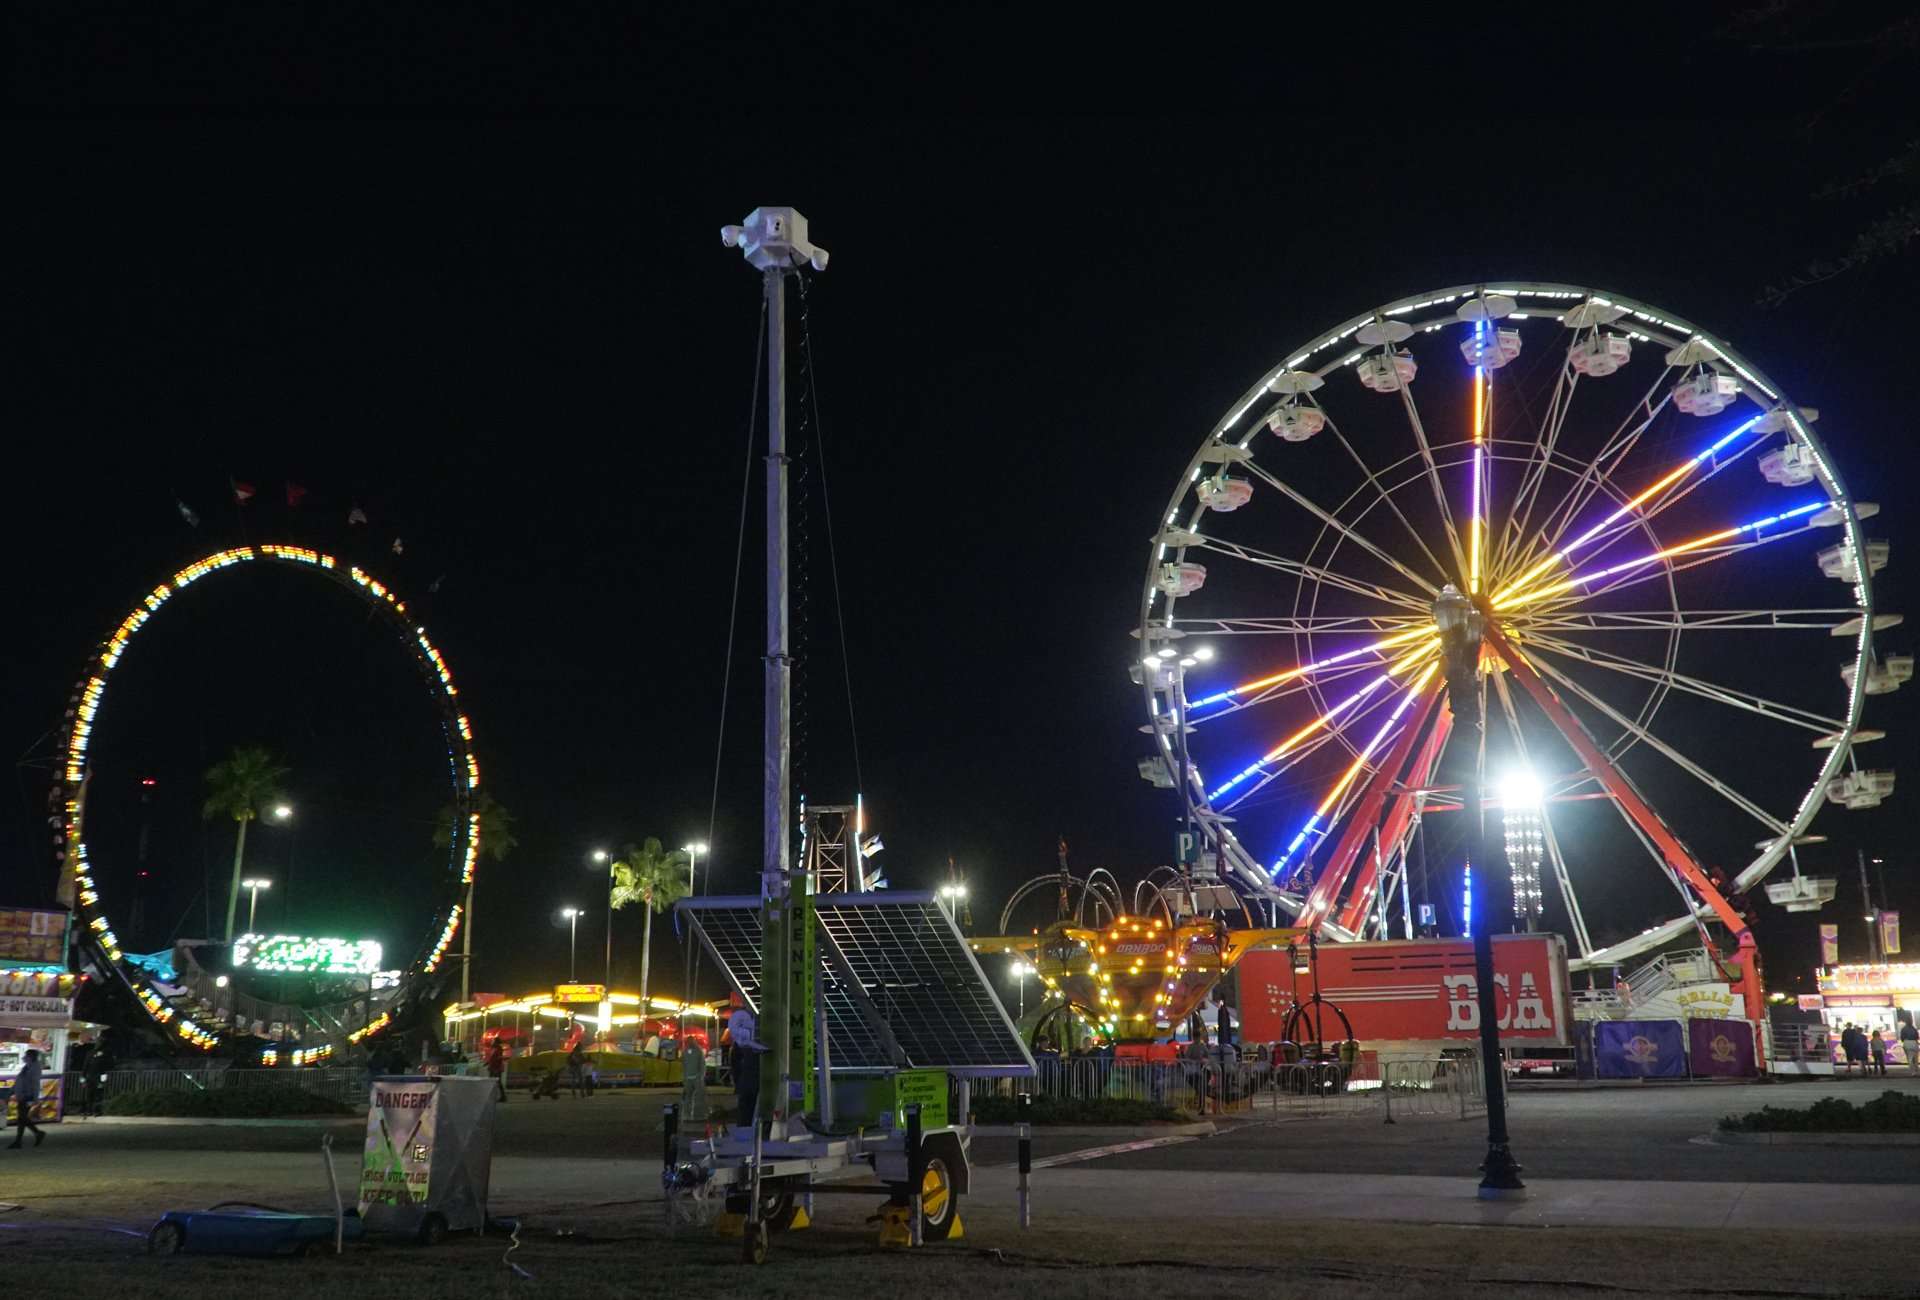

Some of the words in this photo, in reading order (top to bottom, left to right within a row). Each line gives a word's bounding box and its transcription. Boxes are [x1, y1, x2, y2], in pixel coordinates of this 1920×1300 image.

[1179, 833, 1193, 861] P
[1421, 905, 1431, 924] P
[793, 906, 803, 984] RENT
[791, 1014, 803, 1050] ME
[375, 1092, 432, 1109] DANGER!
